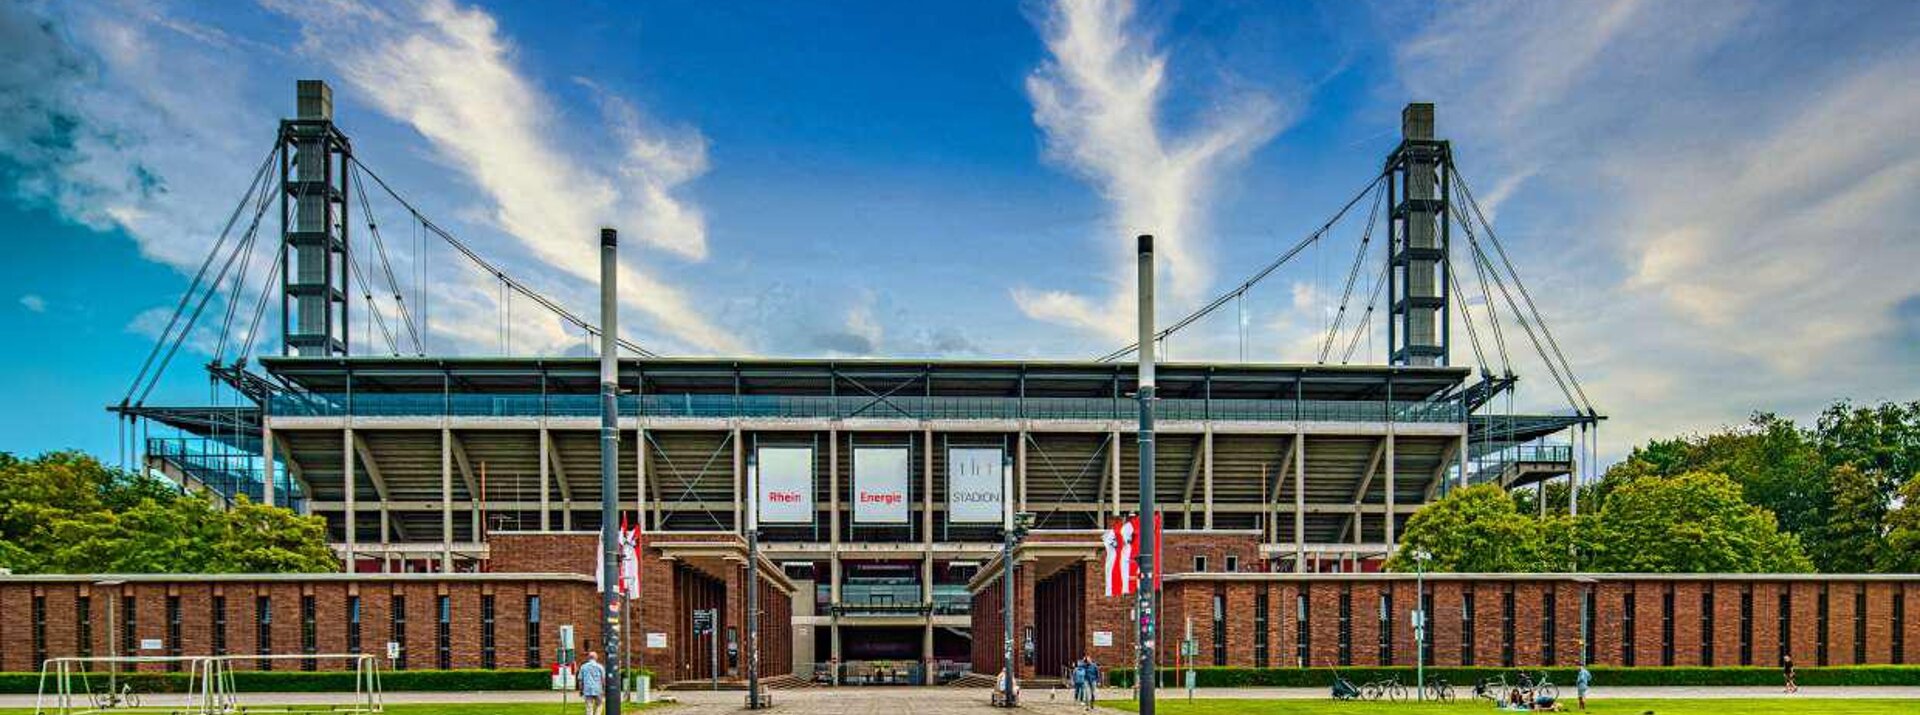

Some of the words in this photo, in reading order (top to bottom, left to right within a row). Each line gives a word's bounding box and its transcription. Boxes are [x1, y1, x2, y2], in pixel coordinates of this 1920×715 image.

[768, 491, 802, 502] Rhein
[860, 491, 902, 504] Energie
[952, 491, 1000, 502] STADION
